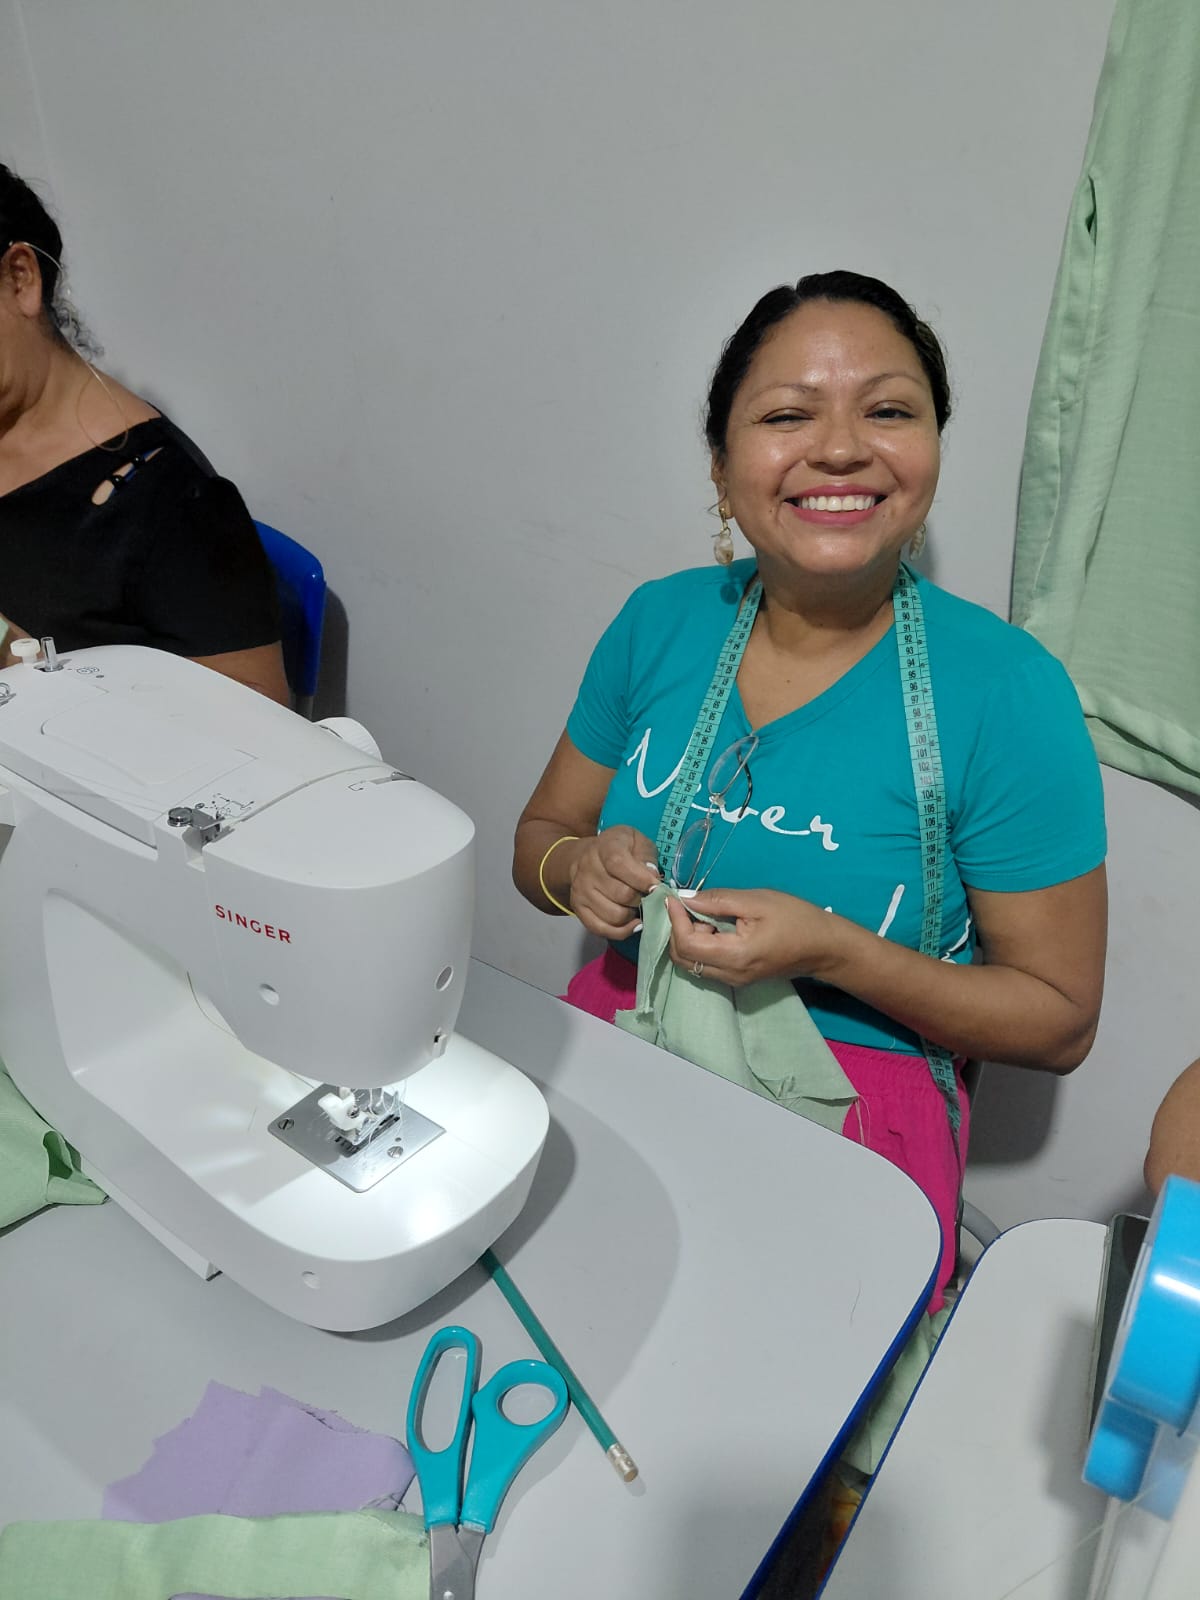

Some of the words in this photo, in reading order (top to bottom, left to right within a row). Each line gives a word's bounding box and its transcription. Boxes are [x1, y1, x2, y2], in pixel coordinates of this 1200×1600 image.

[902, 612, 910, 620] 90
[904, 623, 910, 632] 91
[905, 635, 912, 643] 92
[906, 646, 913, 655] 93
[907, 658, 914, 667] 94
[908, 670, 916, 679] 95
[910, 682, 917, 690] 96
[911, 695, 918, 704] 97
[915, 735, 926, 744] 100
[917, 748, 927, 758] 101
[918, 762, 929, 771] 102
[920, 776, 932, 784] 103
[627, 728, 839, 850] Vver
[922, 790, 934, 800] 104
[924, 804, 934, 813] 105
[925, 818, 935, 827] 106
[926, 831, 936, 840] 107
[927, 857, 935, 866] 109
[927, 870, 935, 879] 110
[215, 904, 291, 943] SINGER
